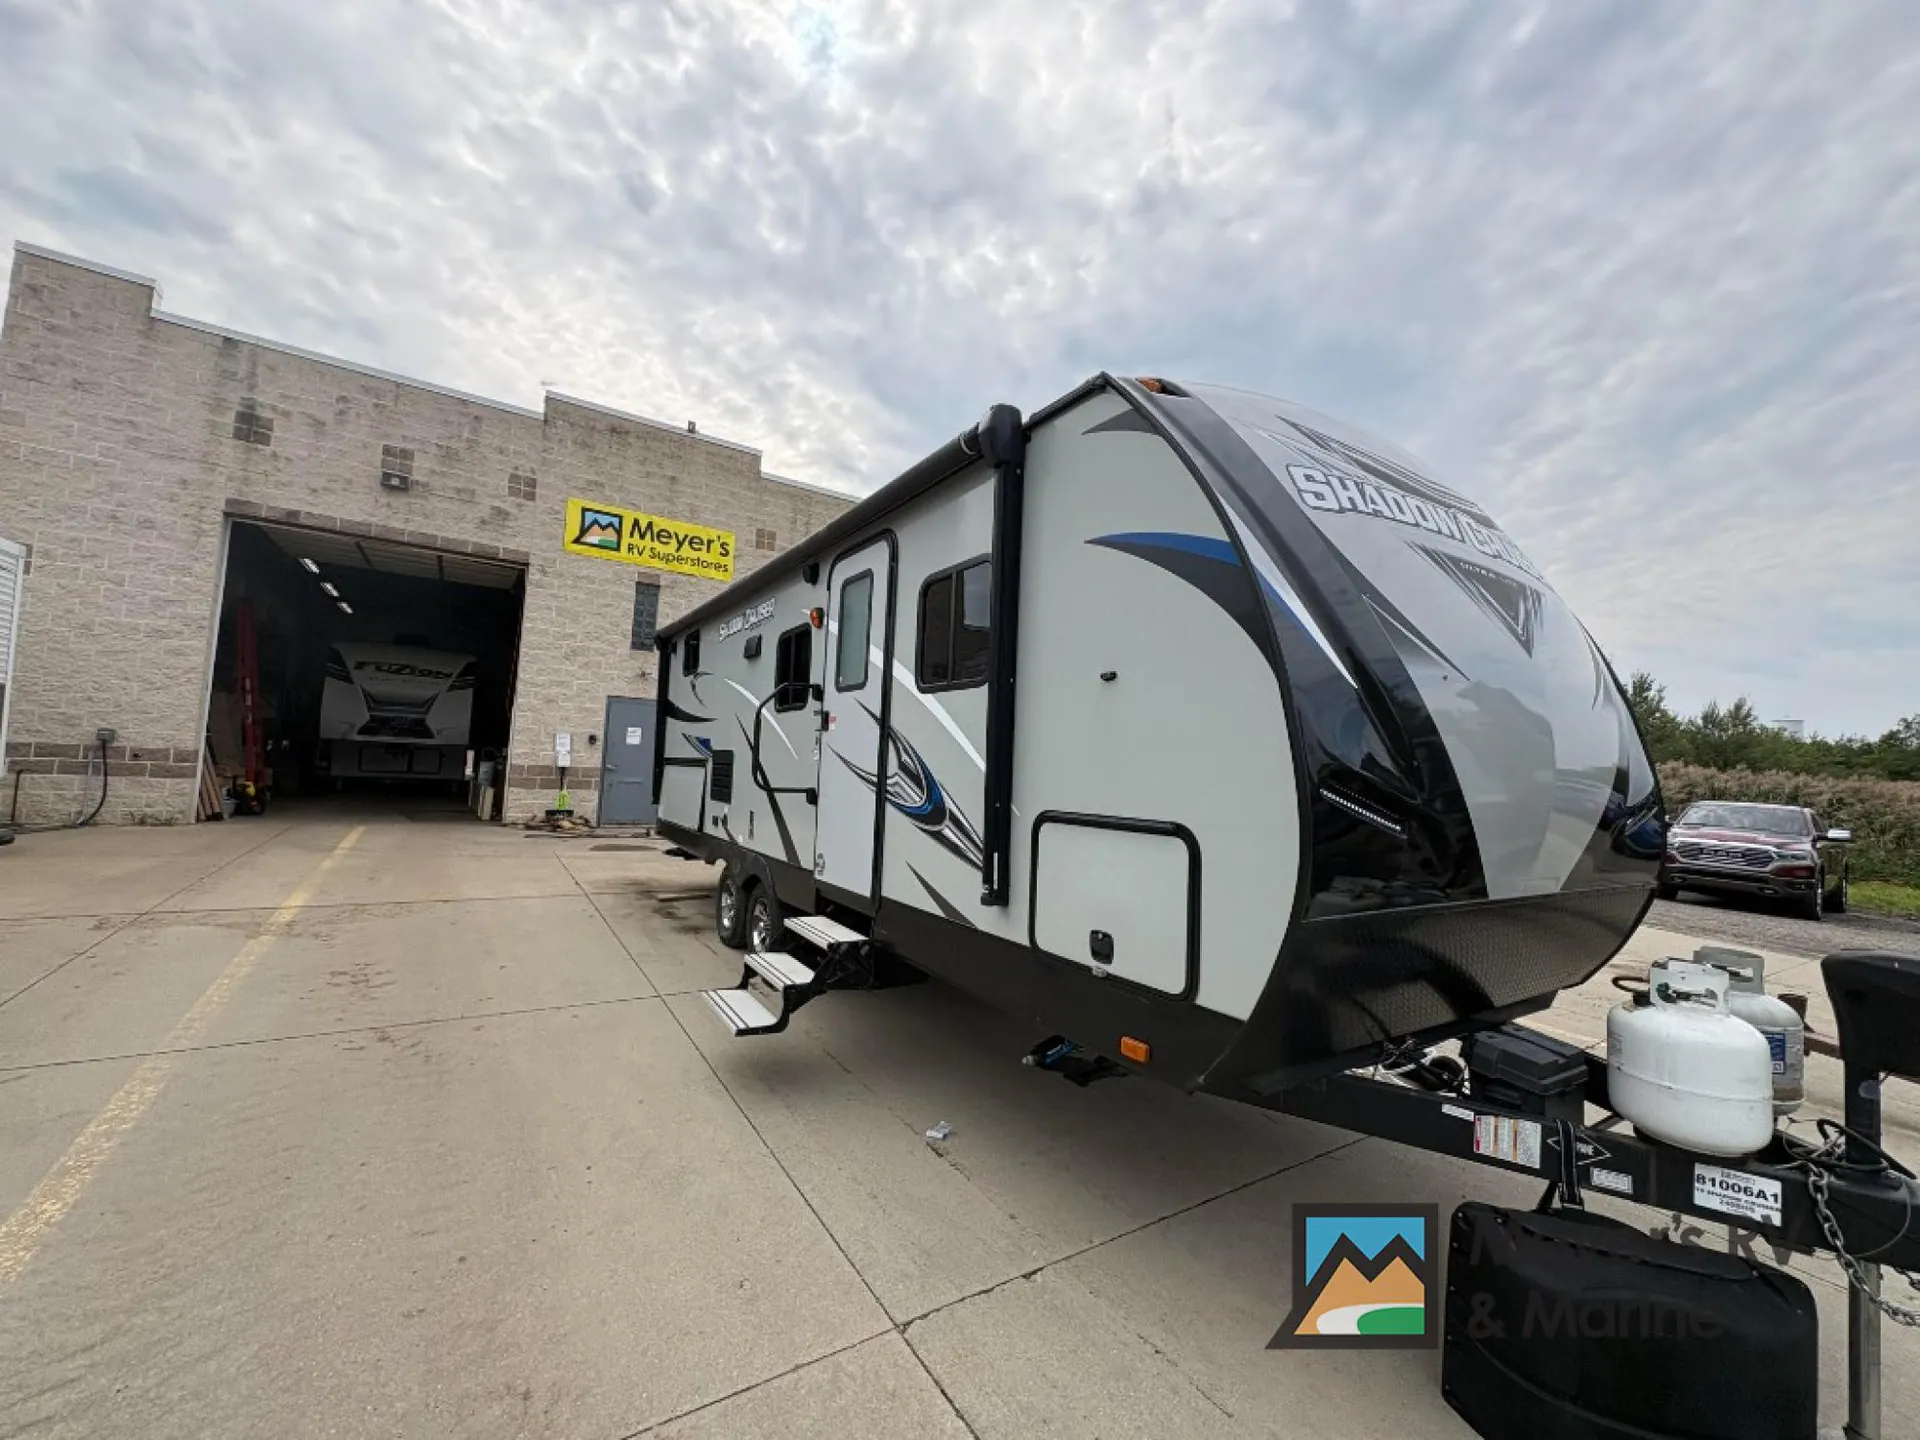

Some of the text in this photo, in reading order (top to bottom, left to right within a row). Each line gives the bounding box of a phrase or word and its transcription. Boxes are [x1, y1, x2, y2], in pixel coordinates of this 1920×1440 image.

[1286, 463, 1466, 544] SHADOW
[629, 517, 731, 558] Meyer's
[627, 543, 729, 573] RV Superstores
[1695, 1172, 1780, 1204] 81006A1
